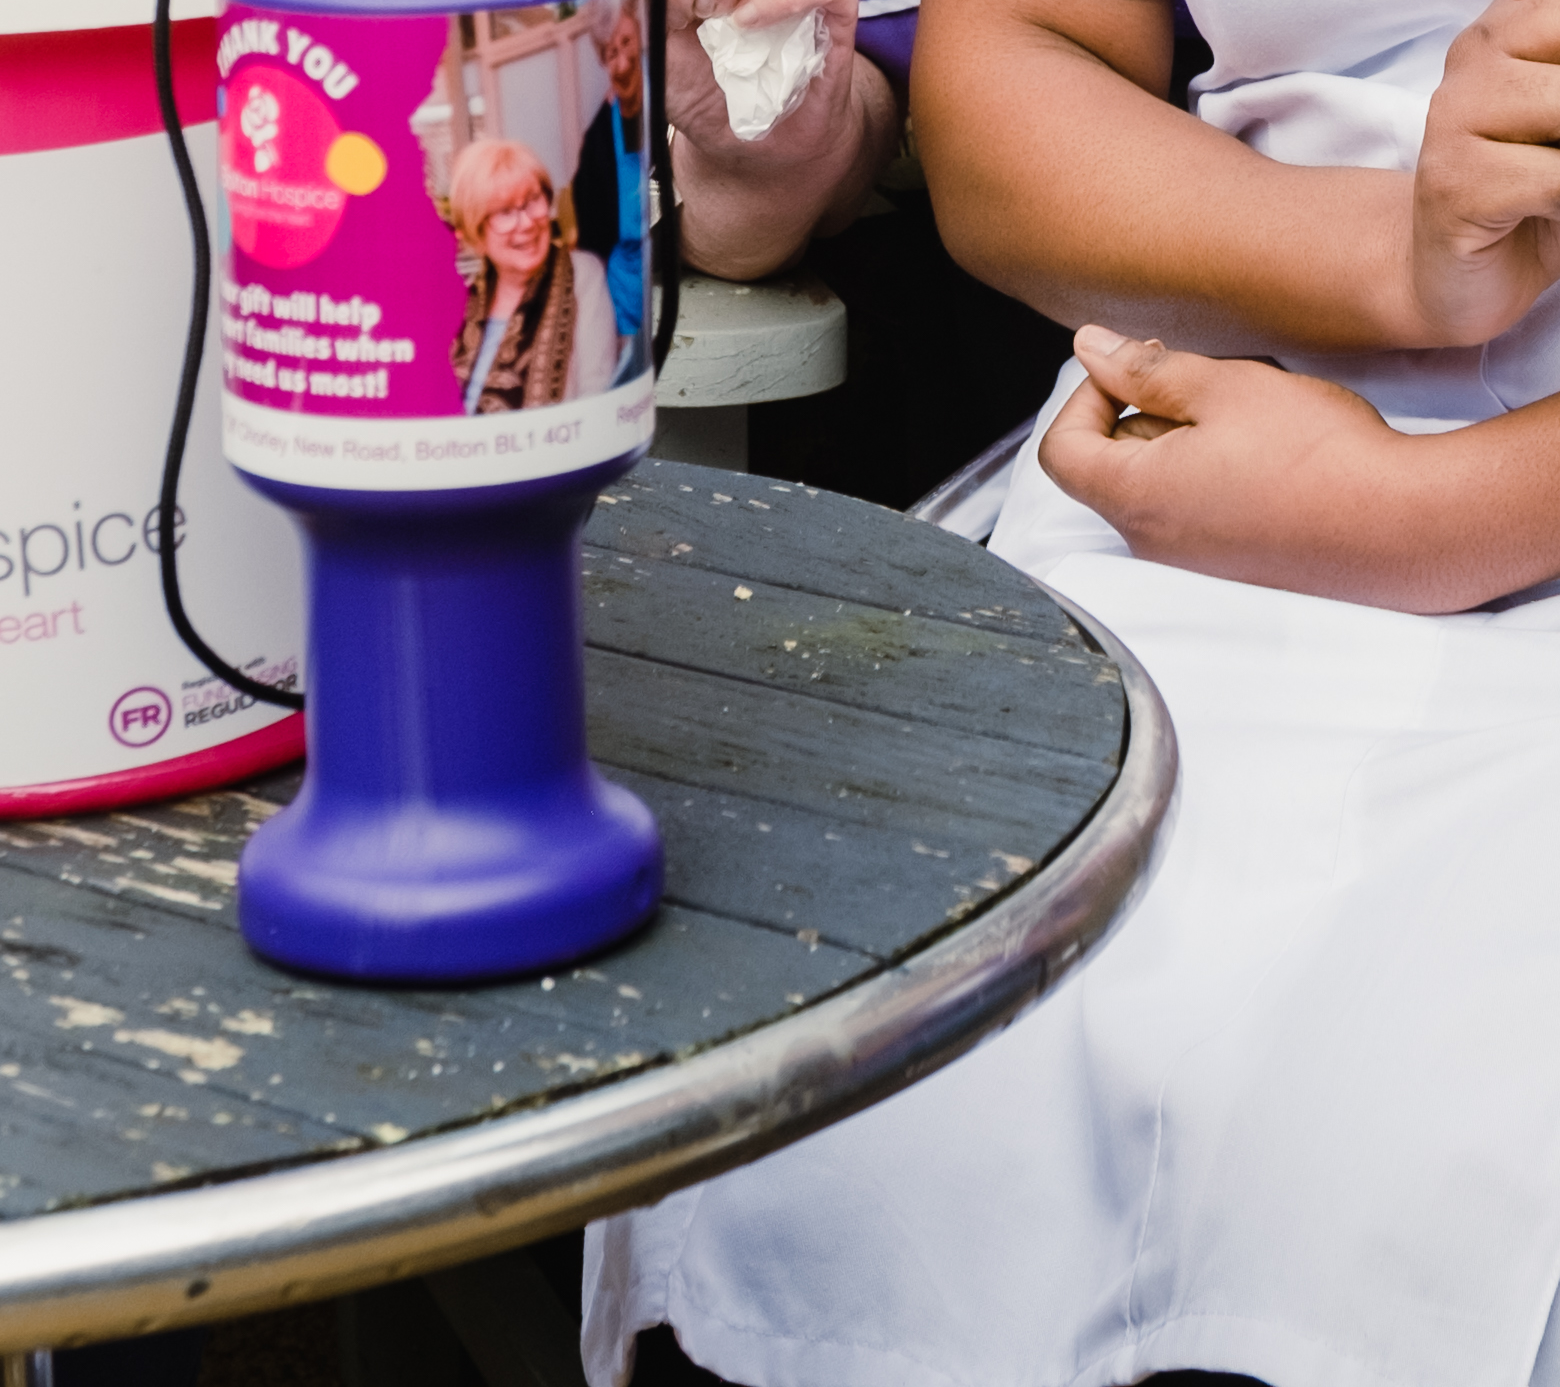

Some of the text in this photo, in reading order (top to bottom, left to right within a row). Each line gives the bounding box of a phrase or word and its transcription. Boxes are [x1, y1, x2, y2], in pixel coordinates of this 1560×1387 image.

[286, 26, 361, 100] YOU
[272, 289, 317, 324] will
[318, 293, 382, 333] help
[245, 317, 333, 361] families
[333, 333, 416, 363] when
[277, 366, 308, 394] us
[308, 367, 389, 400] most!
[293, 434, 335, 458] New
[413, 436, 487, 462] Bolton
[120, 704, 162, 733] FR
